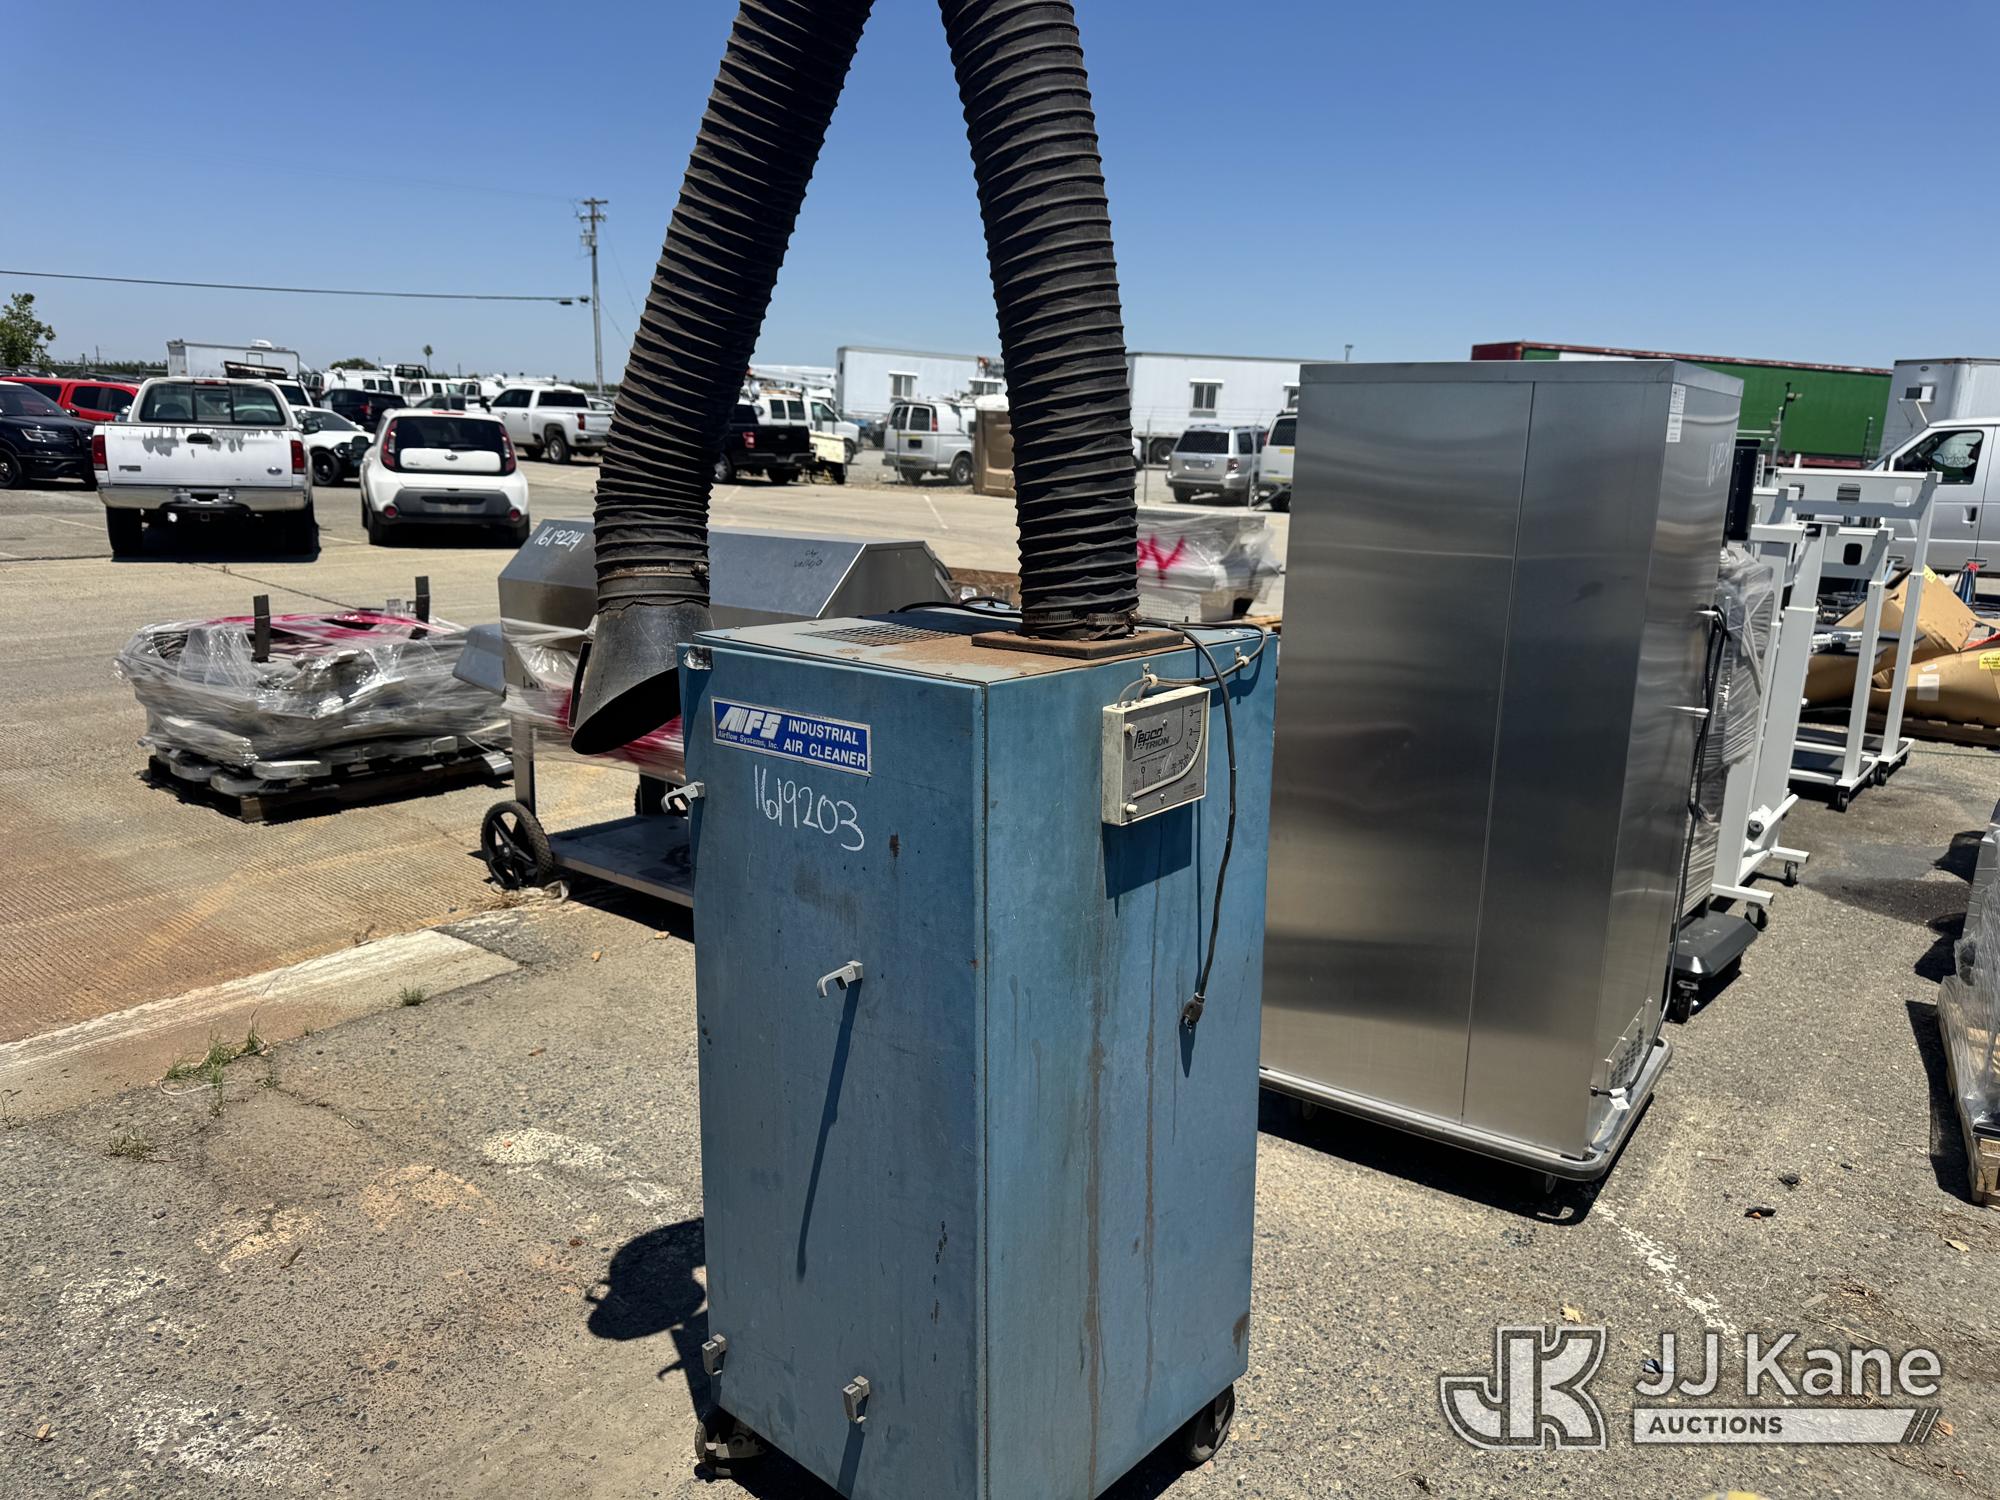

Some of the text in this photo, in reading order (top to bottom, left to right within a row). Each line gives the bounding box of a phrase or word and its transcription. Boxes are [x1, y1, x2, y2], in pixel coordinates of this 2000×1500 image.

[718, 730, 779, 749] Airflow Systems, Inc.
[788, 719, 859, 745] INDUSTRIAL
[1145, 736, 1169, 750] TRION
[783, 738, 866, 767] AIR CLEANER
[754, 764, 865, 851] 1619203
